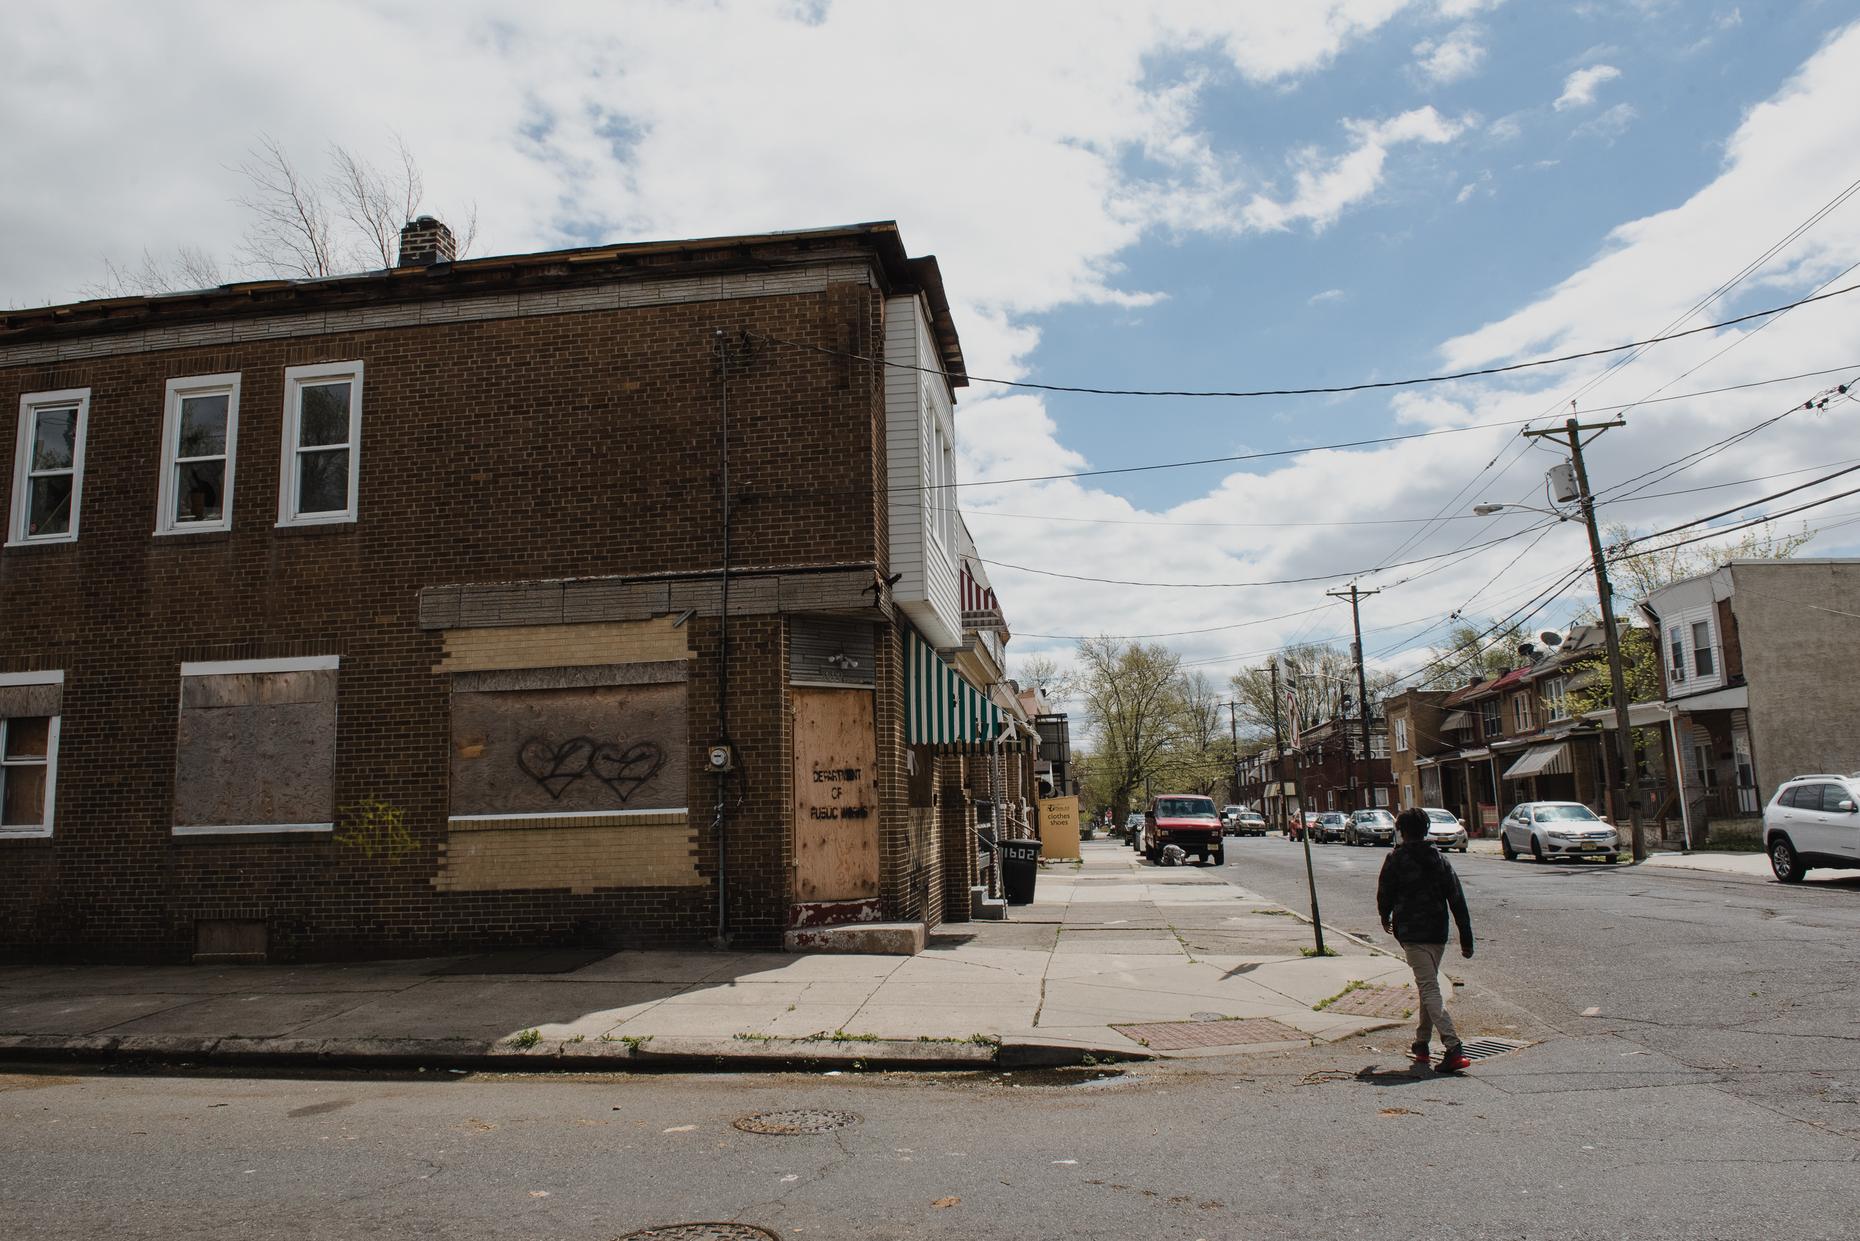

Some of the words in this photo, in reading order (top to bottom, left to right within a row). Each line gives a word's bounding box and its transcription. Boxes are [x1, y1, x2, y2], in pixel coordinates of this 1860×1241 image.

[831, 787, 842, 799] OF
[811, 806, 838, 820] PUBLIC
[1004, 847, 1035, 860] 1602
